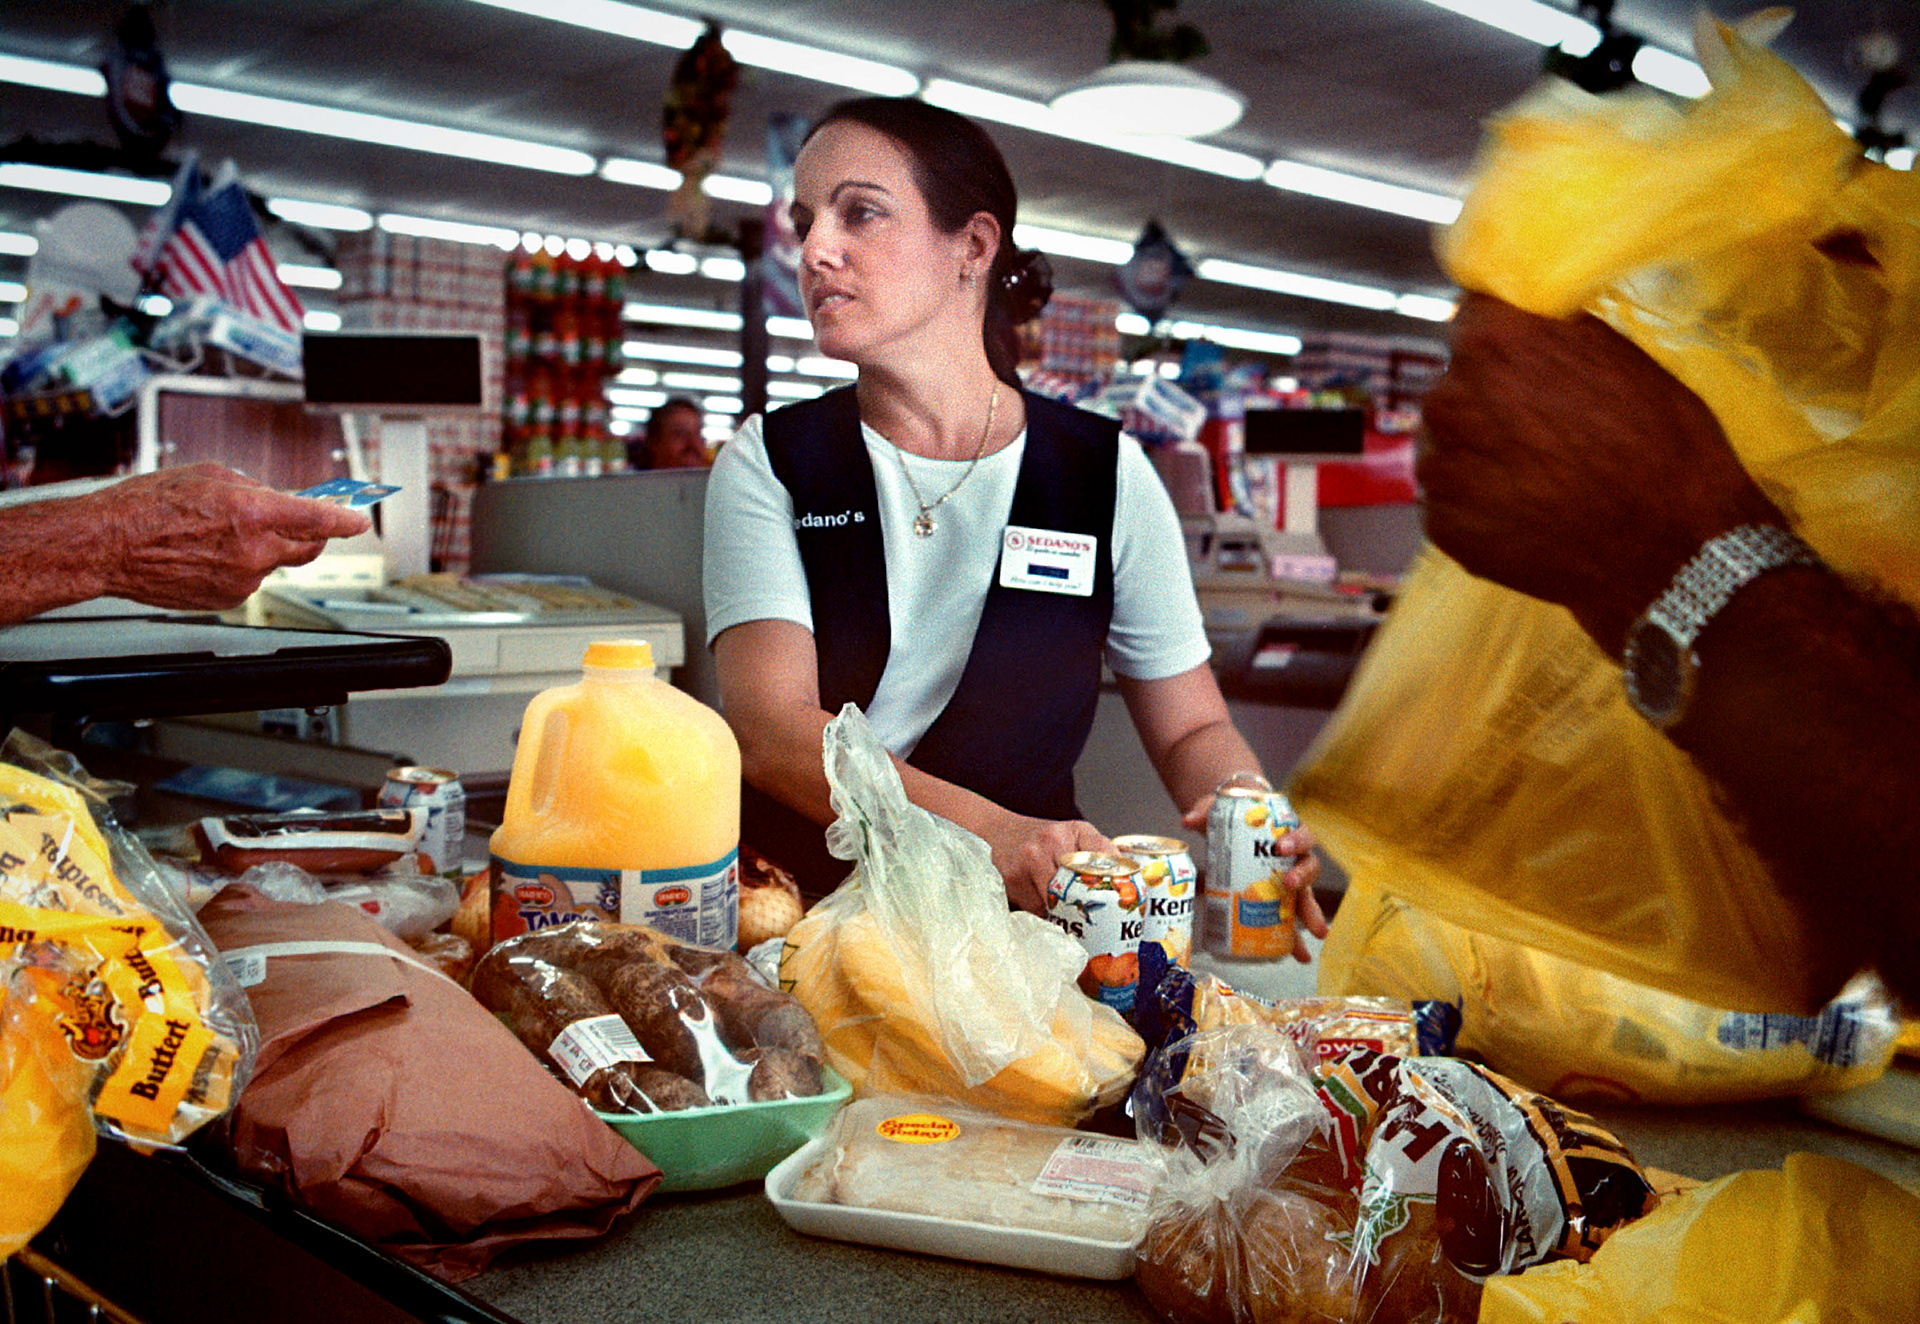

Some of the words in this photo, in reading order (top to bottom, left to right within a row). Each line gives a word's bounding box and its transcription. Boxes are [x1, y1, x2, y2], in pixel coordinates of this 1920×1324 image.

[1027, 536, 1091, 553] SEDANO'S
[881, 1119, 954, 1131] Special
[883, 1127, 950, 1139] Today!
